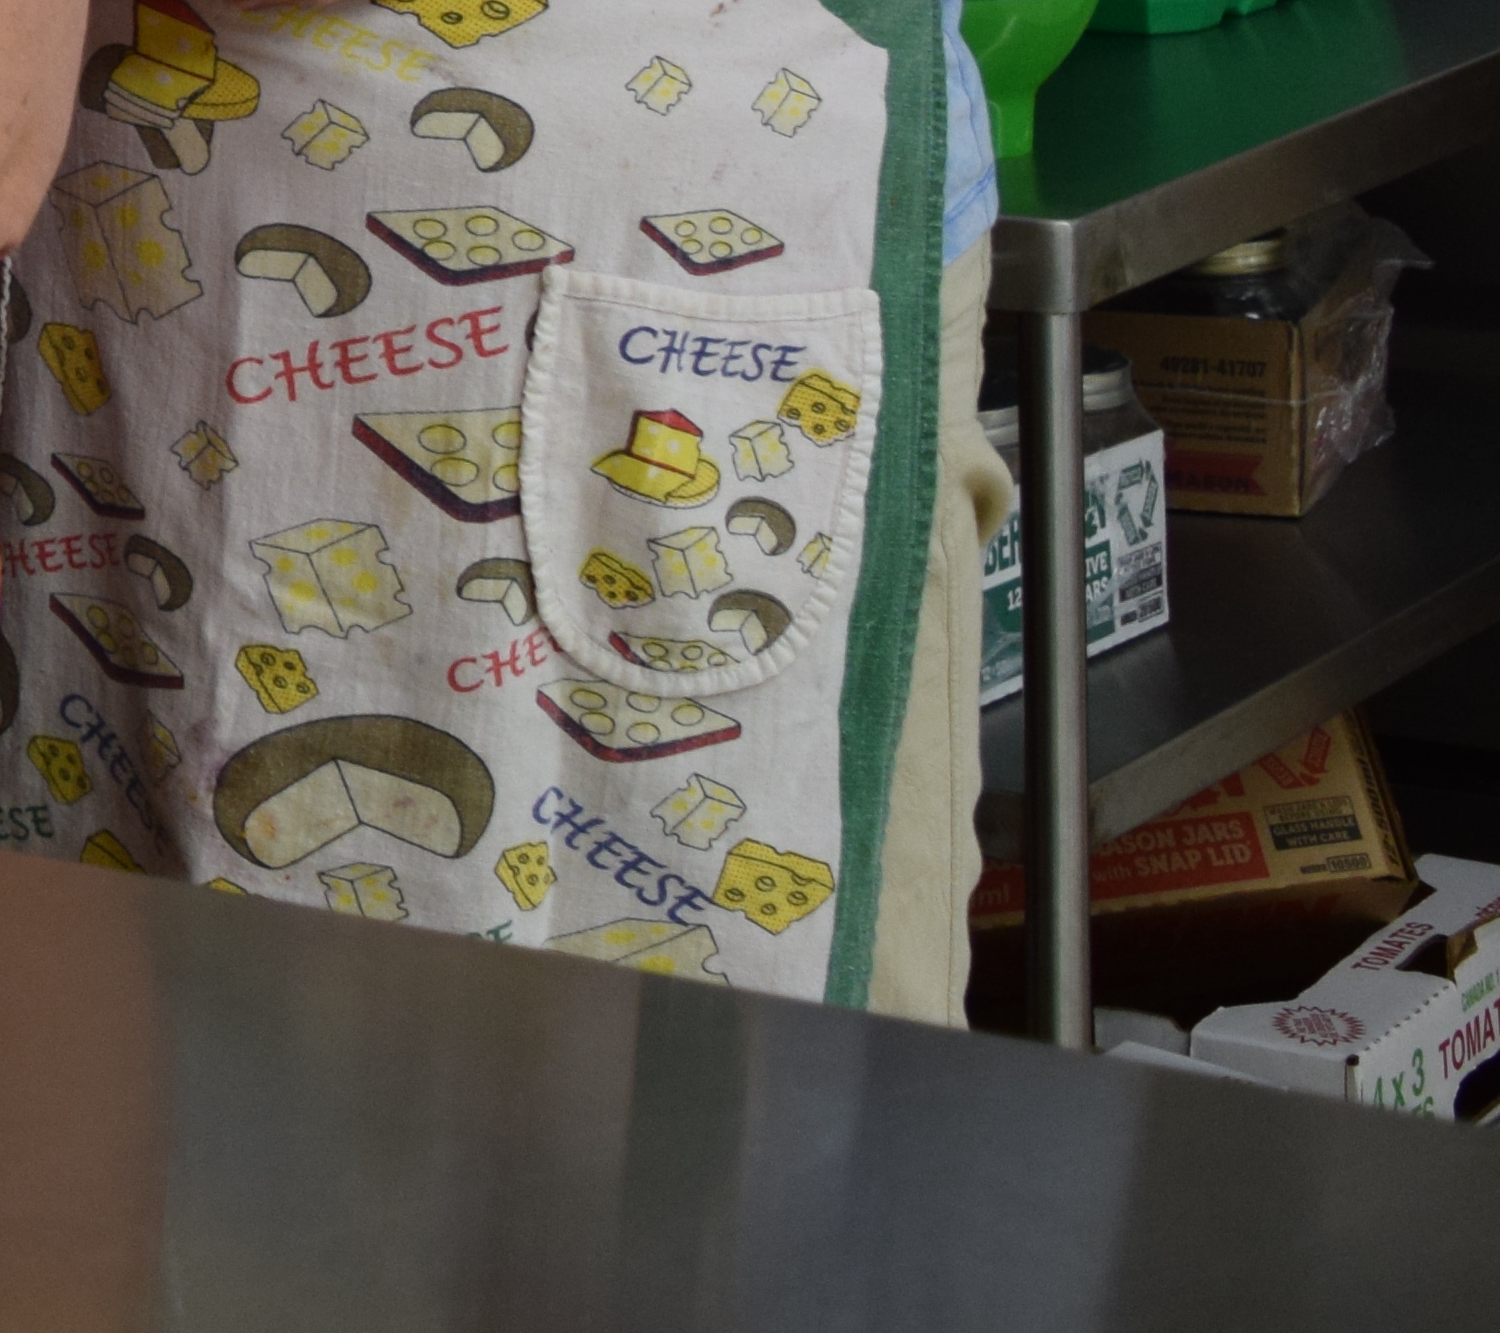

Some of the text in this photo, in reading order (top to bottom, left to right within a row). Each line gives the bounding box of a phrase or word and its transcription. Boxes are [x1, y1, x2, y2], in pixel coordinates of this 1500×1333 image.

[225, 306, 511, 406] CHEESE
[618, 325, 808, 384] CHEESE
[1, 533, 122, 581] HEESE
[531, 786, 717, 928] CHEESE
[1181, 819, 1244, 846] JARS
[1134, 848, 1202, 878] SNAP
[1209, 842, 1252, 867] LID
[1352, 921, 1434, 971] TOMATES
[1411, 1047, 1425, 1097] 3
